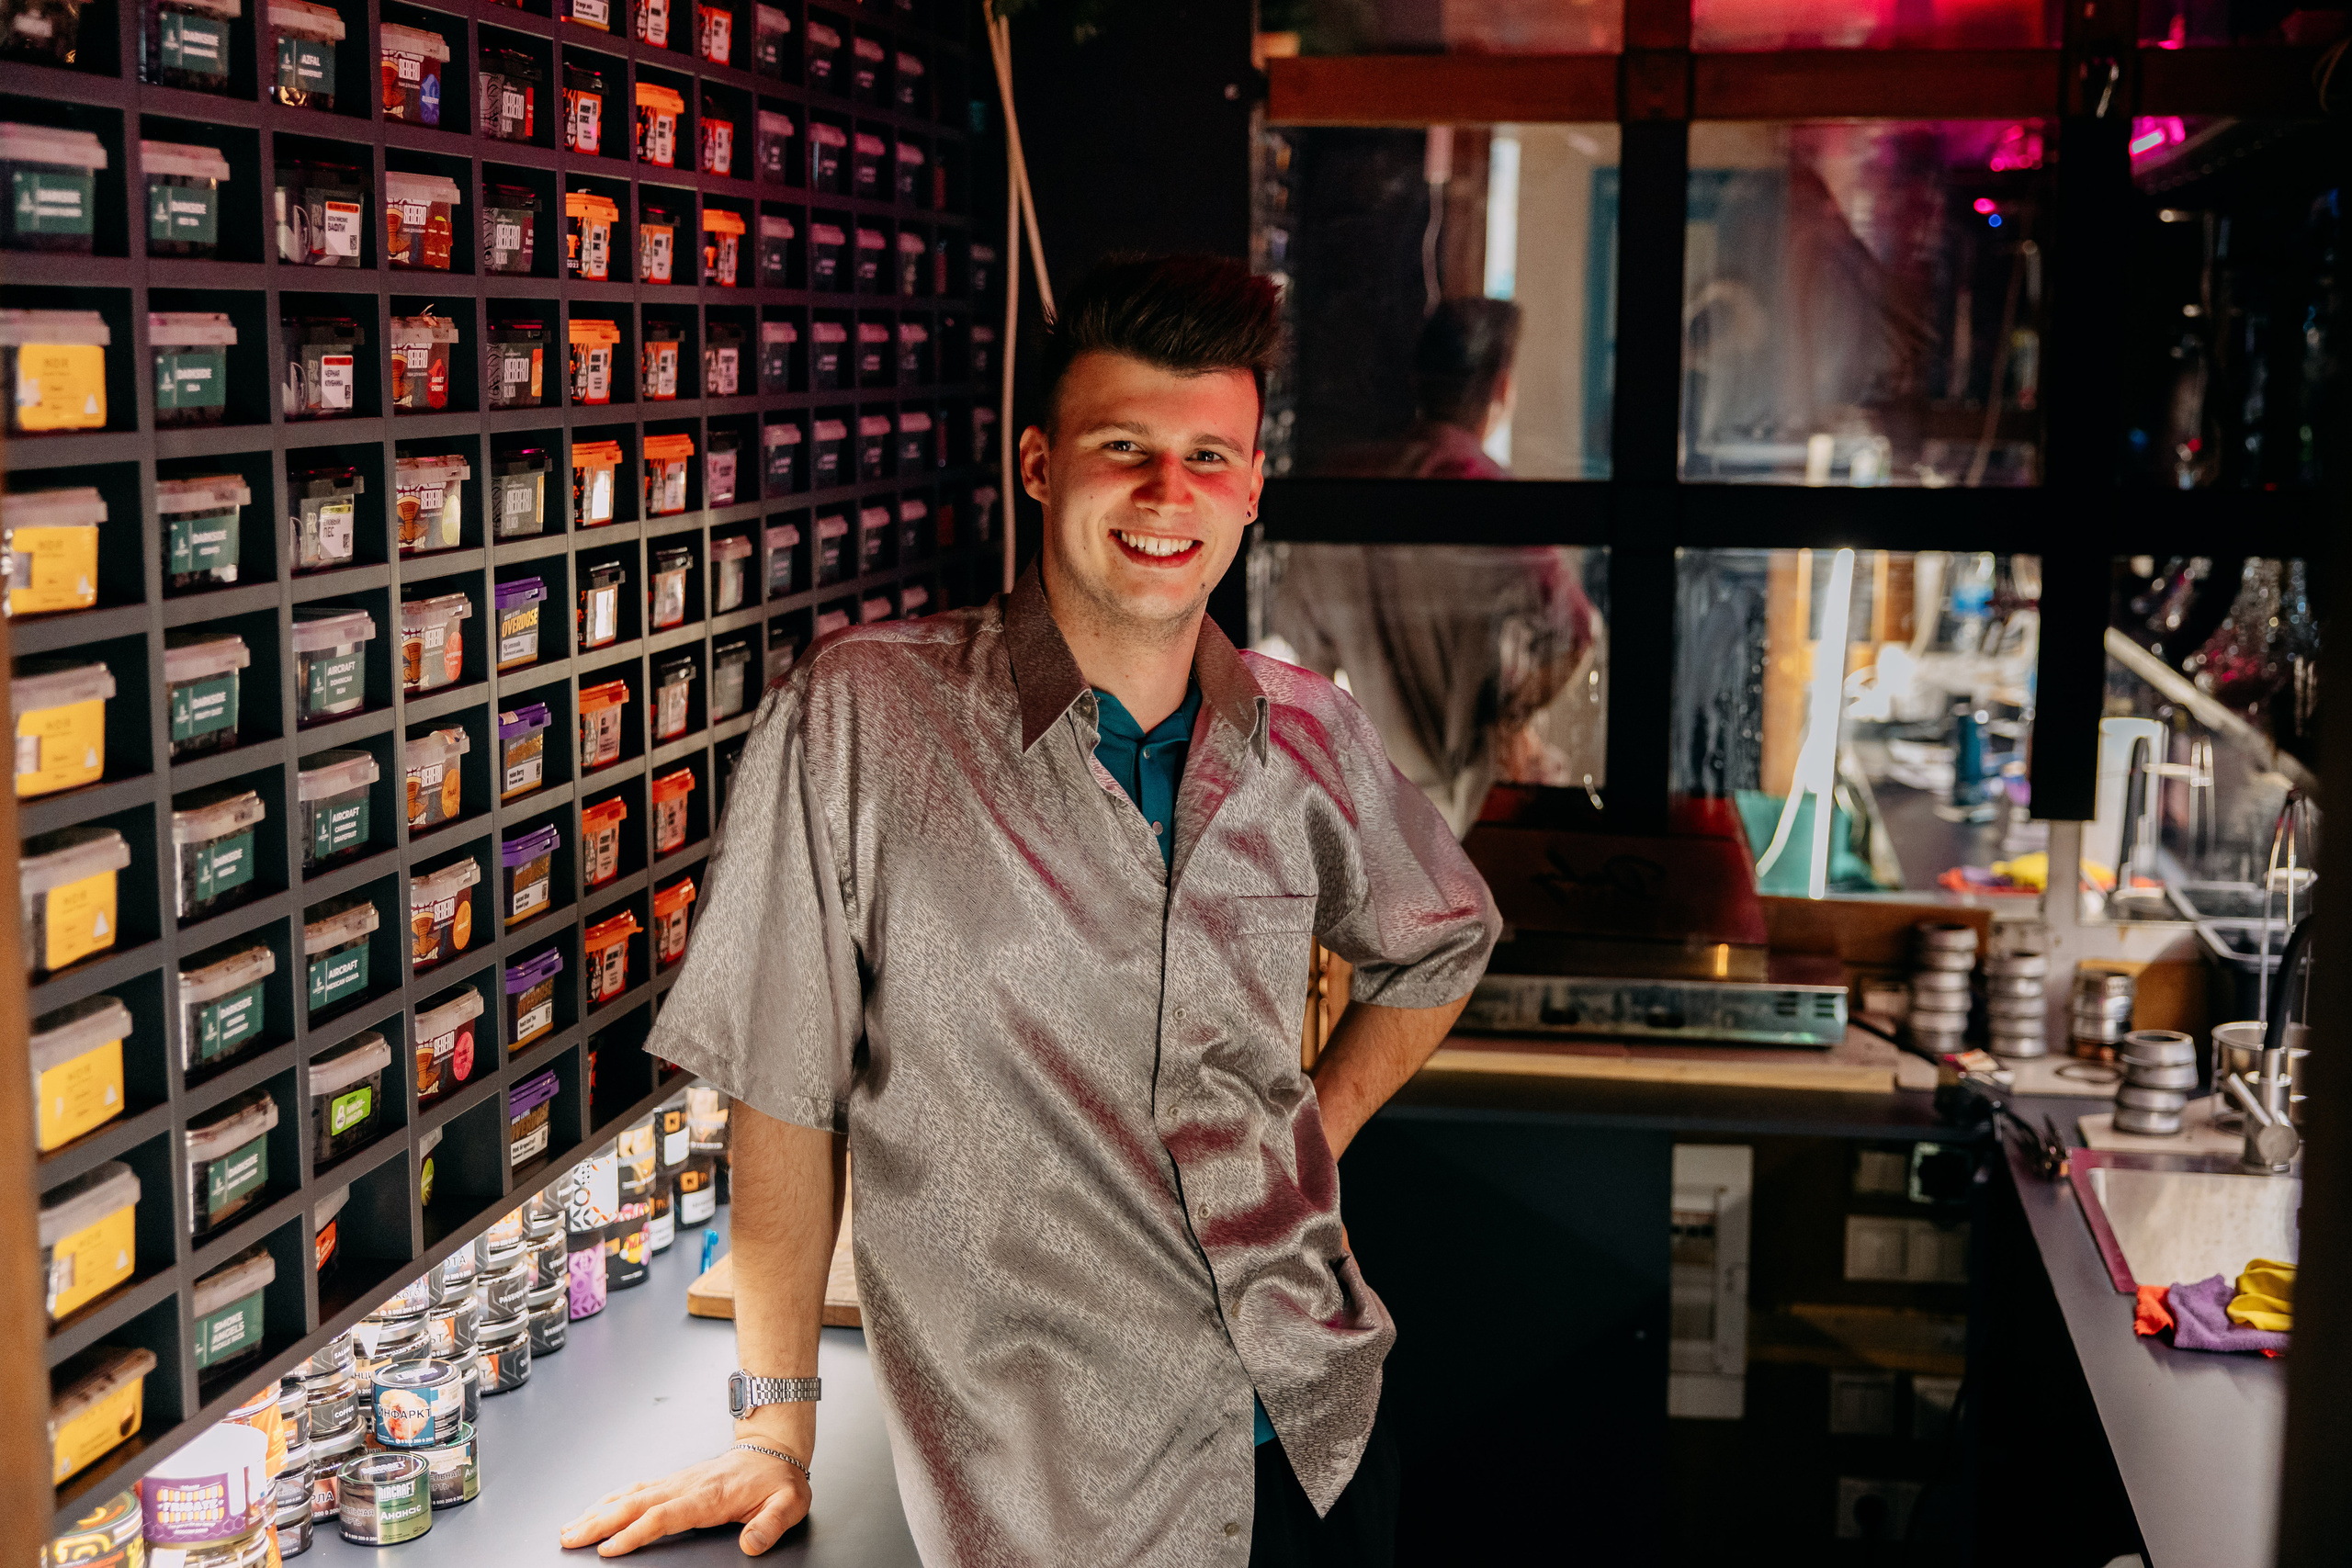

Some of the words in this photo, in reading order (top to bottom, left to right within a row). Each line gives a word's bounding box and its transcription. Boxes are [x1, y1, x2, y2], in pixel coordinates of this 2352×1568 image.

[301, 53, 321, 67] AZFAL
[323, 526, 334, 537] ЛЕС
[502, 607, 538, 637] OVERDOSE
[327, 660, 356, 676] AIRCRAFT
[421, 763, 443, 788] SEBERO
[332, 806, 360, 823] AIRCRAFT
[434, 897, 455, 922] SEBERO
[328, 958, 358, 979] AIRCRAFT
[326, 980, 345, 991] MEXICAN
[434, 1031, 455, 1057] SEBERO
[212, 1311, 243, 1332] SMOKE
[212, 1321, 245, 1345] ANGELS
[334, 1404, 354, 1418] COFFEE
[378, 1404, 431, 1419] ИНФАРКТ
[378, 1481, 415, 1500] AIRCRAFT
[380, 1505, 422, 1520] Ананас
